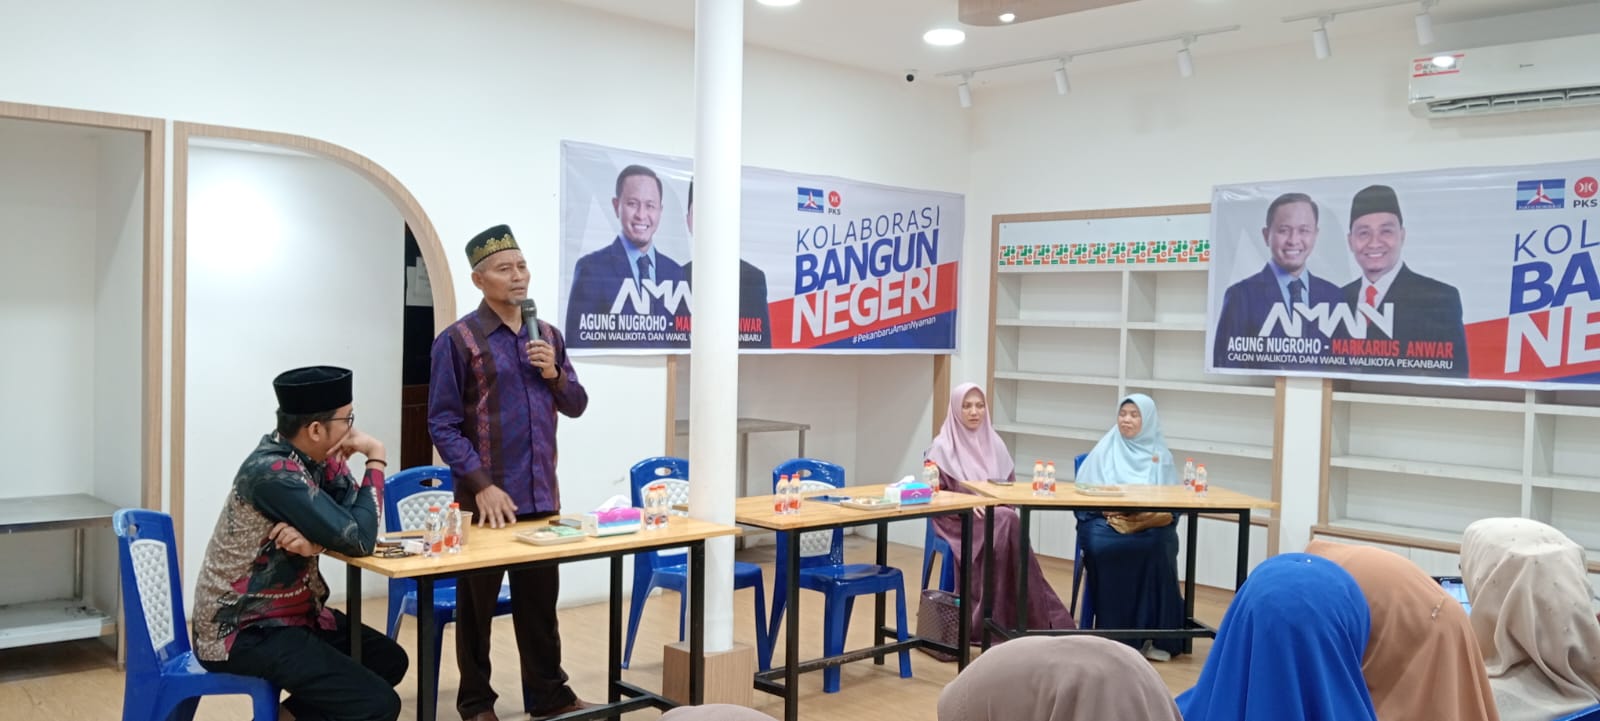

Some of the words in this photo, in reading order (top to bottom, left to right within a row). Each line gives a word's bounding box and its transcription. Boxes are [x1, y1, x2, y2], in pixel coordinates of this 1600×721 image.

[828, 207, 841, 216] PKS
[1573, 199, 1598, 208] PKS
[796, 205, 940, 253] KOLABORASI
[794, 228, 939, 296] BANGUN
[791, 266, 938, 344] NEGERI
[579, 313, 616, 330] AGUNG
[618, 315, 667, 331] NUGROHO
[852, 316, 936, 344] #PekanbaruAmanNyaman
[1258, 301, 1394, 340] AMAN
[580, 331, 607, 341] CALON
[607, 332, 645, 341] WALIKOTA
[647, 332, 664, 341] DAN
[665, 333, 688, 342] WAKIL
[1227, 336, 1264, 352] AGUNG
[1266, 337, 1321, 354] NUGROHO
[1332, 339, 1400, 357] MARKARIUS
[1406, 341, 1454, 359] ANWAR
[1227, 352, 1255, 362] CALON
[1256, 353, 1298, 364] WALIKOTA
[1299, 355, 1318, 364] DAN
[1320, 356, 1348, 365] WAKIL
[1348, 356, 1396, 368] WALIKOTA
[1396, 358, 1454, 369] PEKANBARU
